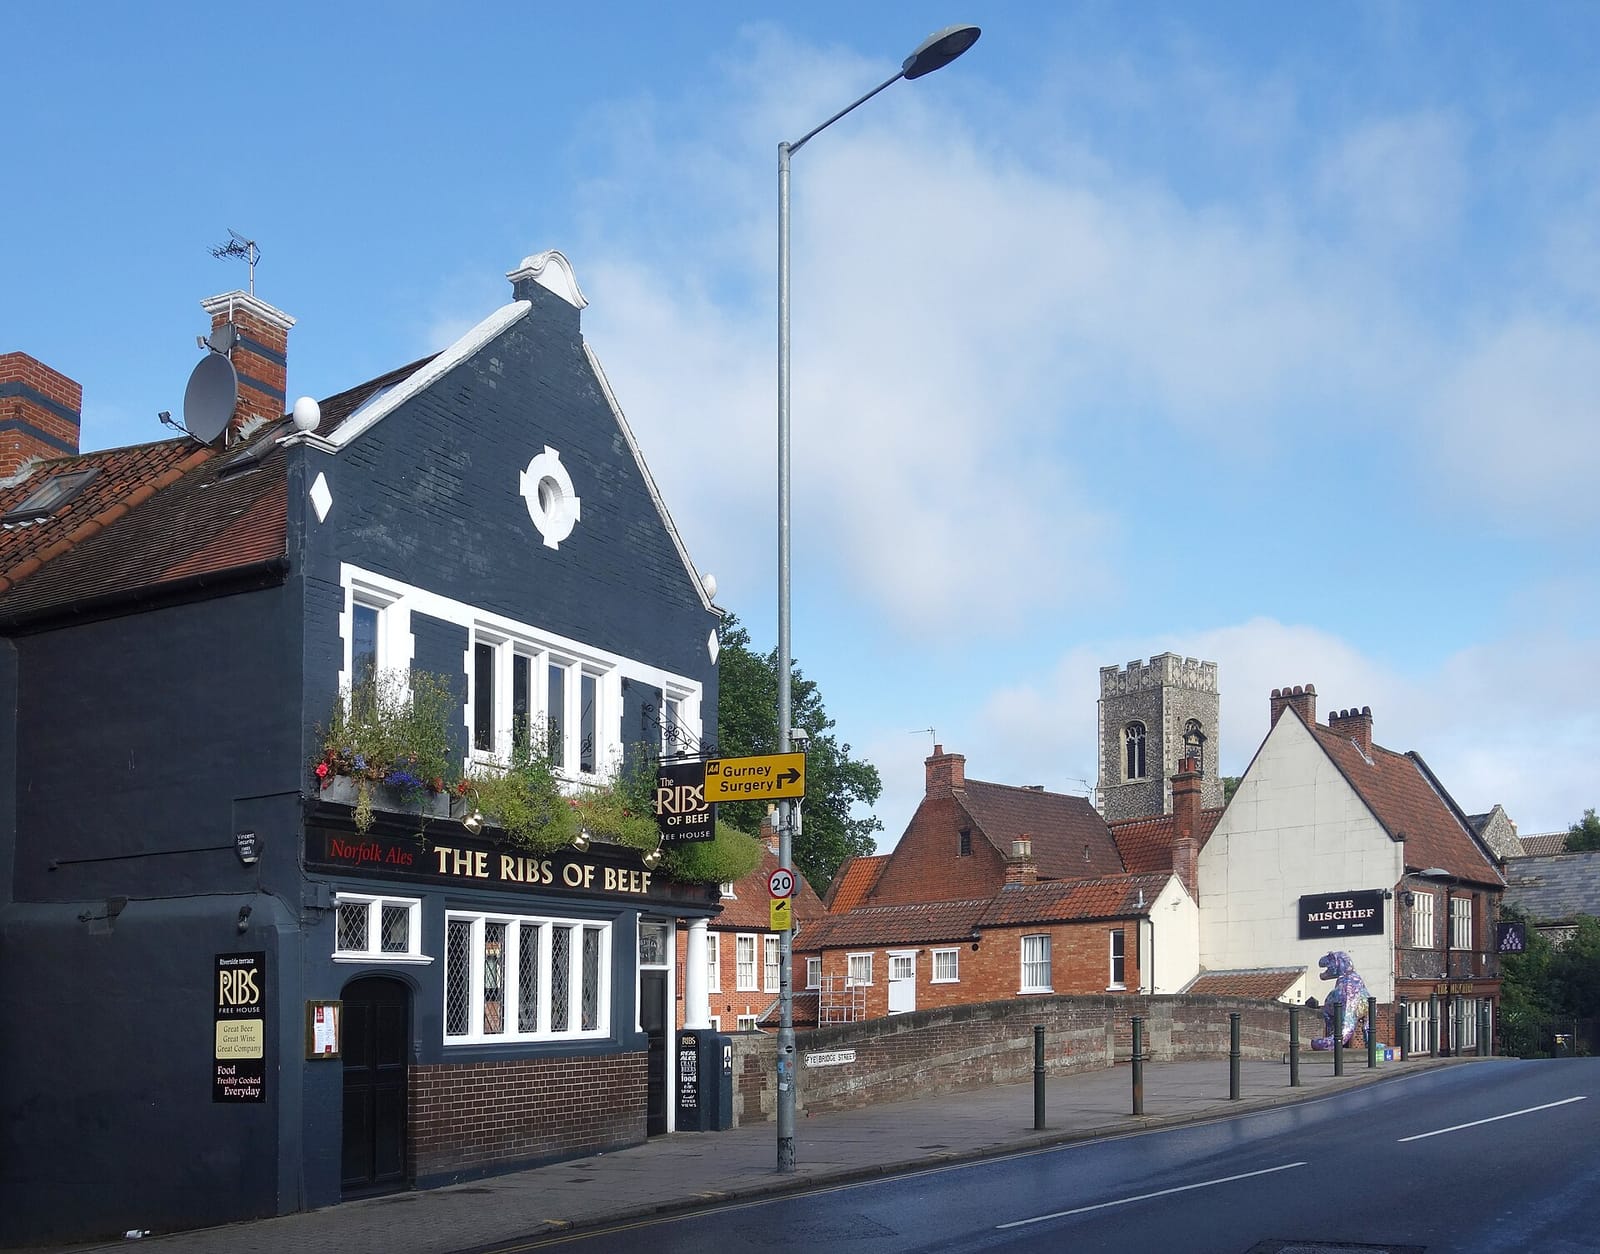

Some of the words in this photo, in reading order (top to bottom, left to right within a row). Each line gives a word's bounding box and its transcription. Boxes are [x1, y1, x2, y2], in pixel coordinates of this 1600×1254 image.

[708, 764, 718, 773] AA
[723, 766, 771, 777] Gurney
[660, 777, 674, 787] The
[720, 781, 773, 793] Surgery
[667, 816, 682, 826] OF
[685, 813, 710, 825] BEEF
[679, 831, 711, 840] HOUSE
[329, 839, 382, 865] Norfolk
[385, 847, 413, 865] Ales
[433, 846, 490, 878] THE
[500, 855, 553, 884] RIBS
[562, 863, 595, 888] OF
[604, 867, 652, 894] BEEF
[772, 877, 791, 891] 20
[1326, 900, 1354, 909] THE
[1308, 909, 1375, 922] MISCHIEF
[219, 968, 260, 1005] RIBS
[236, 1006, 261, 1014] HOUSE
[223, 1025, 239, 1033] Great
[240, 1024, 253, 1032] Beer
[222, 1035, 239, 1043] Great
[240, 1034, 256, 1042] Wine
[217, 1045, 233, 1053] Great
[233, 1044, 262, 1054] Company
[217, 1065, 236, 1075] Food
[217, 1077, 238, 1086] Freshly
[238, 1077, 261, 1085] Cooked
[224, 1086, 261, 1098] Everyday
